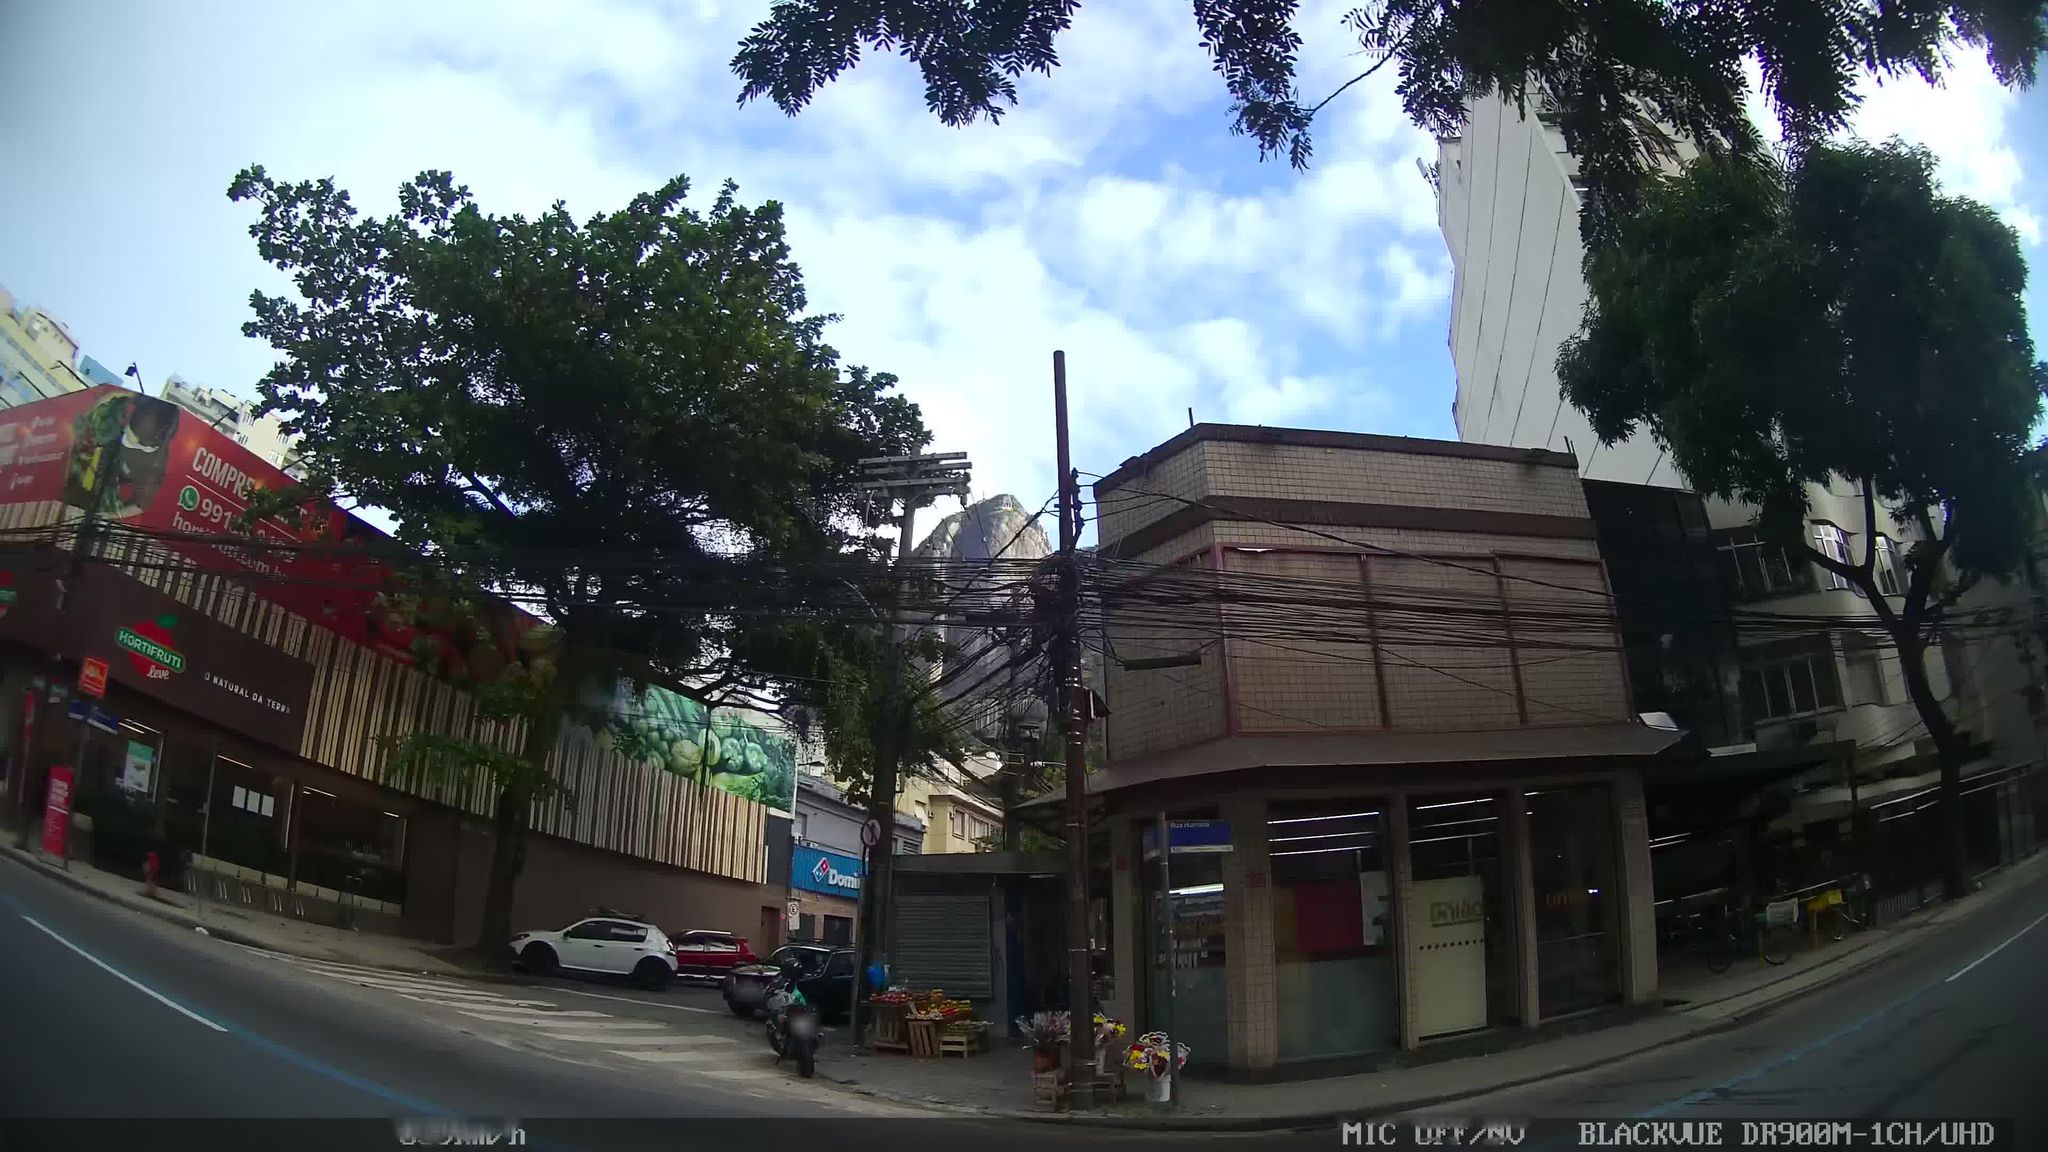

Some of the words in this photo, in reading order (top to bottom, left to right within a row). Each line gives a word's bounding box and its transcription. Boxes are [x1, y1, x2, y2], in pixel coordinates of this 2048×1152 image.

[118, 630, 183, 669] HORTIFRUTI
[212, 675, 250, 698] NATURAL
[252, 692, 264, 704] DA
[266, 698, 291, 714] TERRA
